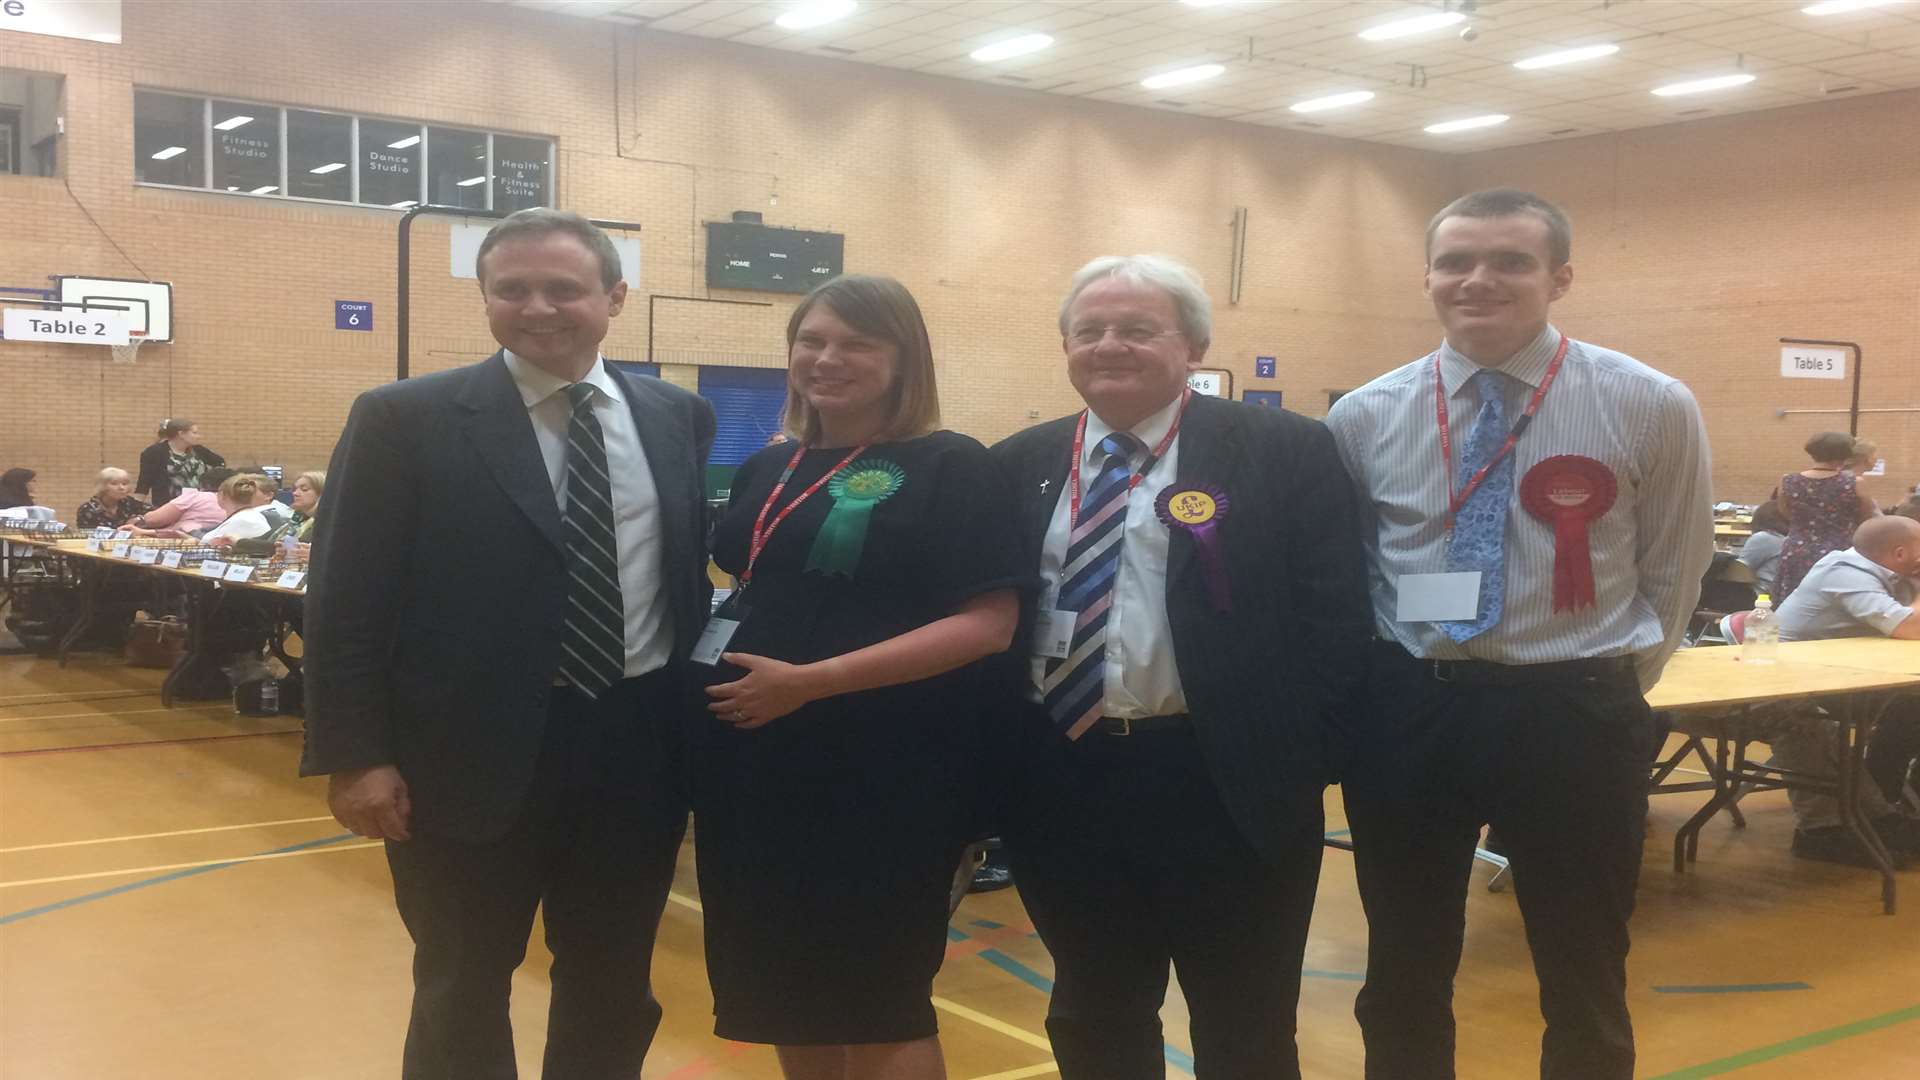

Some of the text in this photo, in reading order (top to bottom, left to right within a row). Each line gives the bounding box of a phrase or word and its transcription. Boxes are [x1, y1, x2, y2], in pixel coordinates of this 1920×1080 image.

[222, 134, 270, 149] Fitness
[223, 145, 268, 159] Studio
[369, 151, 409, 164] Dance
[369, 161, 409, 174] Studio
[501, 159, 540, 171] Health
[516, 170, 525, 179] &
[500, 176, 541, 189] Fitness
[504, 186, 535, 197] Suite
[341, 303, 368, 311] COURT
[349, 313, 360, 326] 6
[28, 318, 107, 337] Table 2
[1794, 356, 1833, 371] Table 5
[1262, 366, 1269, 375] 2
[1203, 380, 1210, 390] 6
[1176, 500, 1207, 512] UKIP
